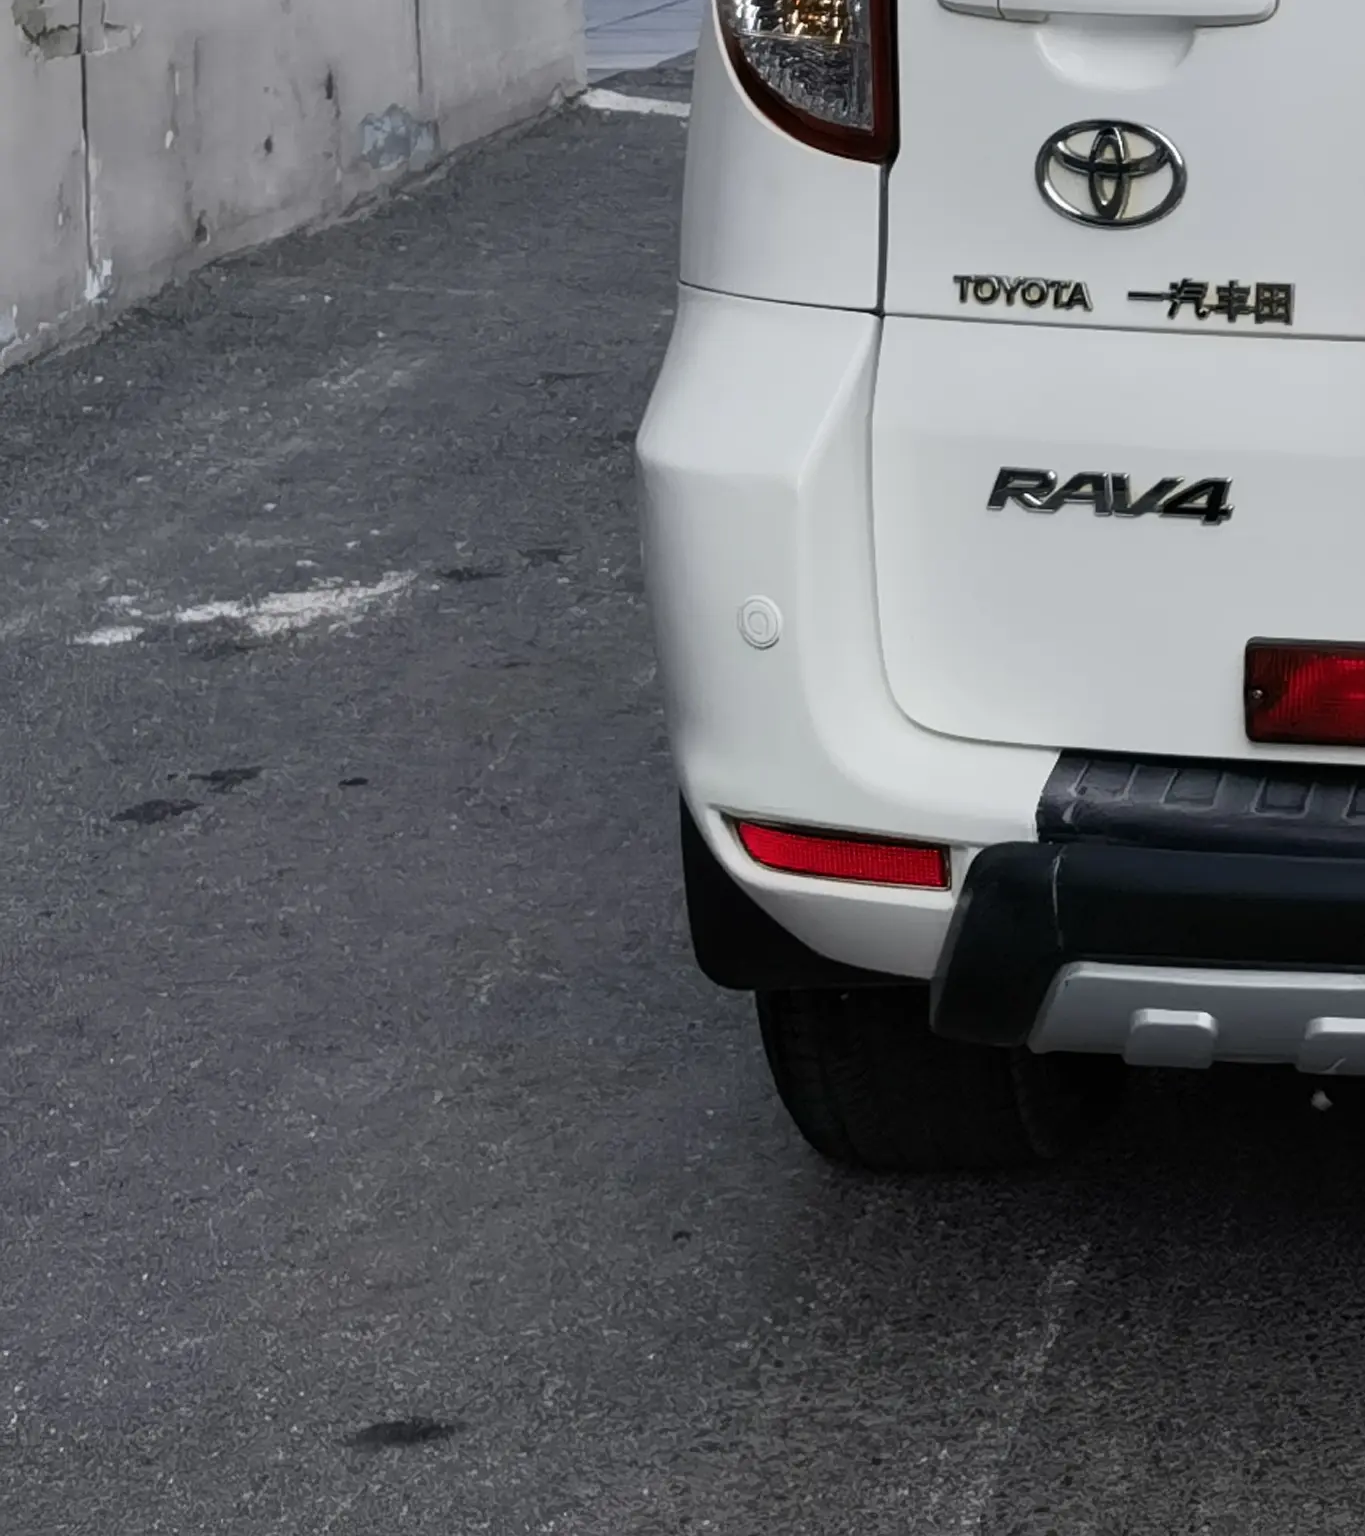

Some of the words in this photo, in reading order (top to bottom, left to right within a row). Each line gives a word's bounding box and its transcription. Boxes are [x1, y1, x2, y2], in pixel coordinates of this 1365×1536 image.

[953, 275, 1094, 312] TOYOTA
[1127, 278, 1296, 326] 一汽丰田
[986, 466, 1235, 526] RAV4
